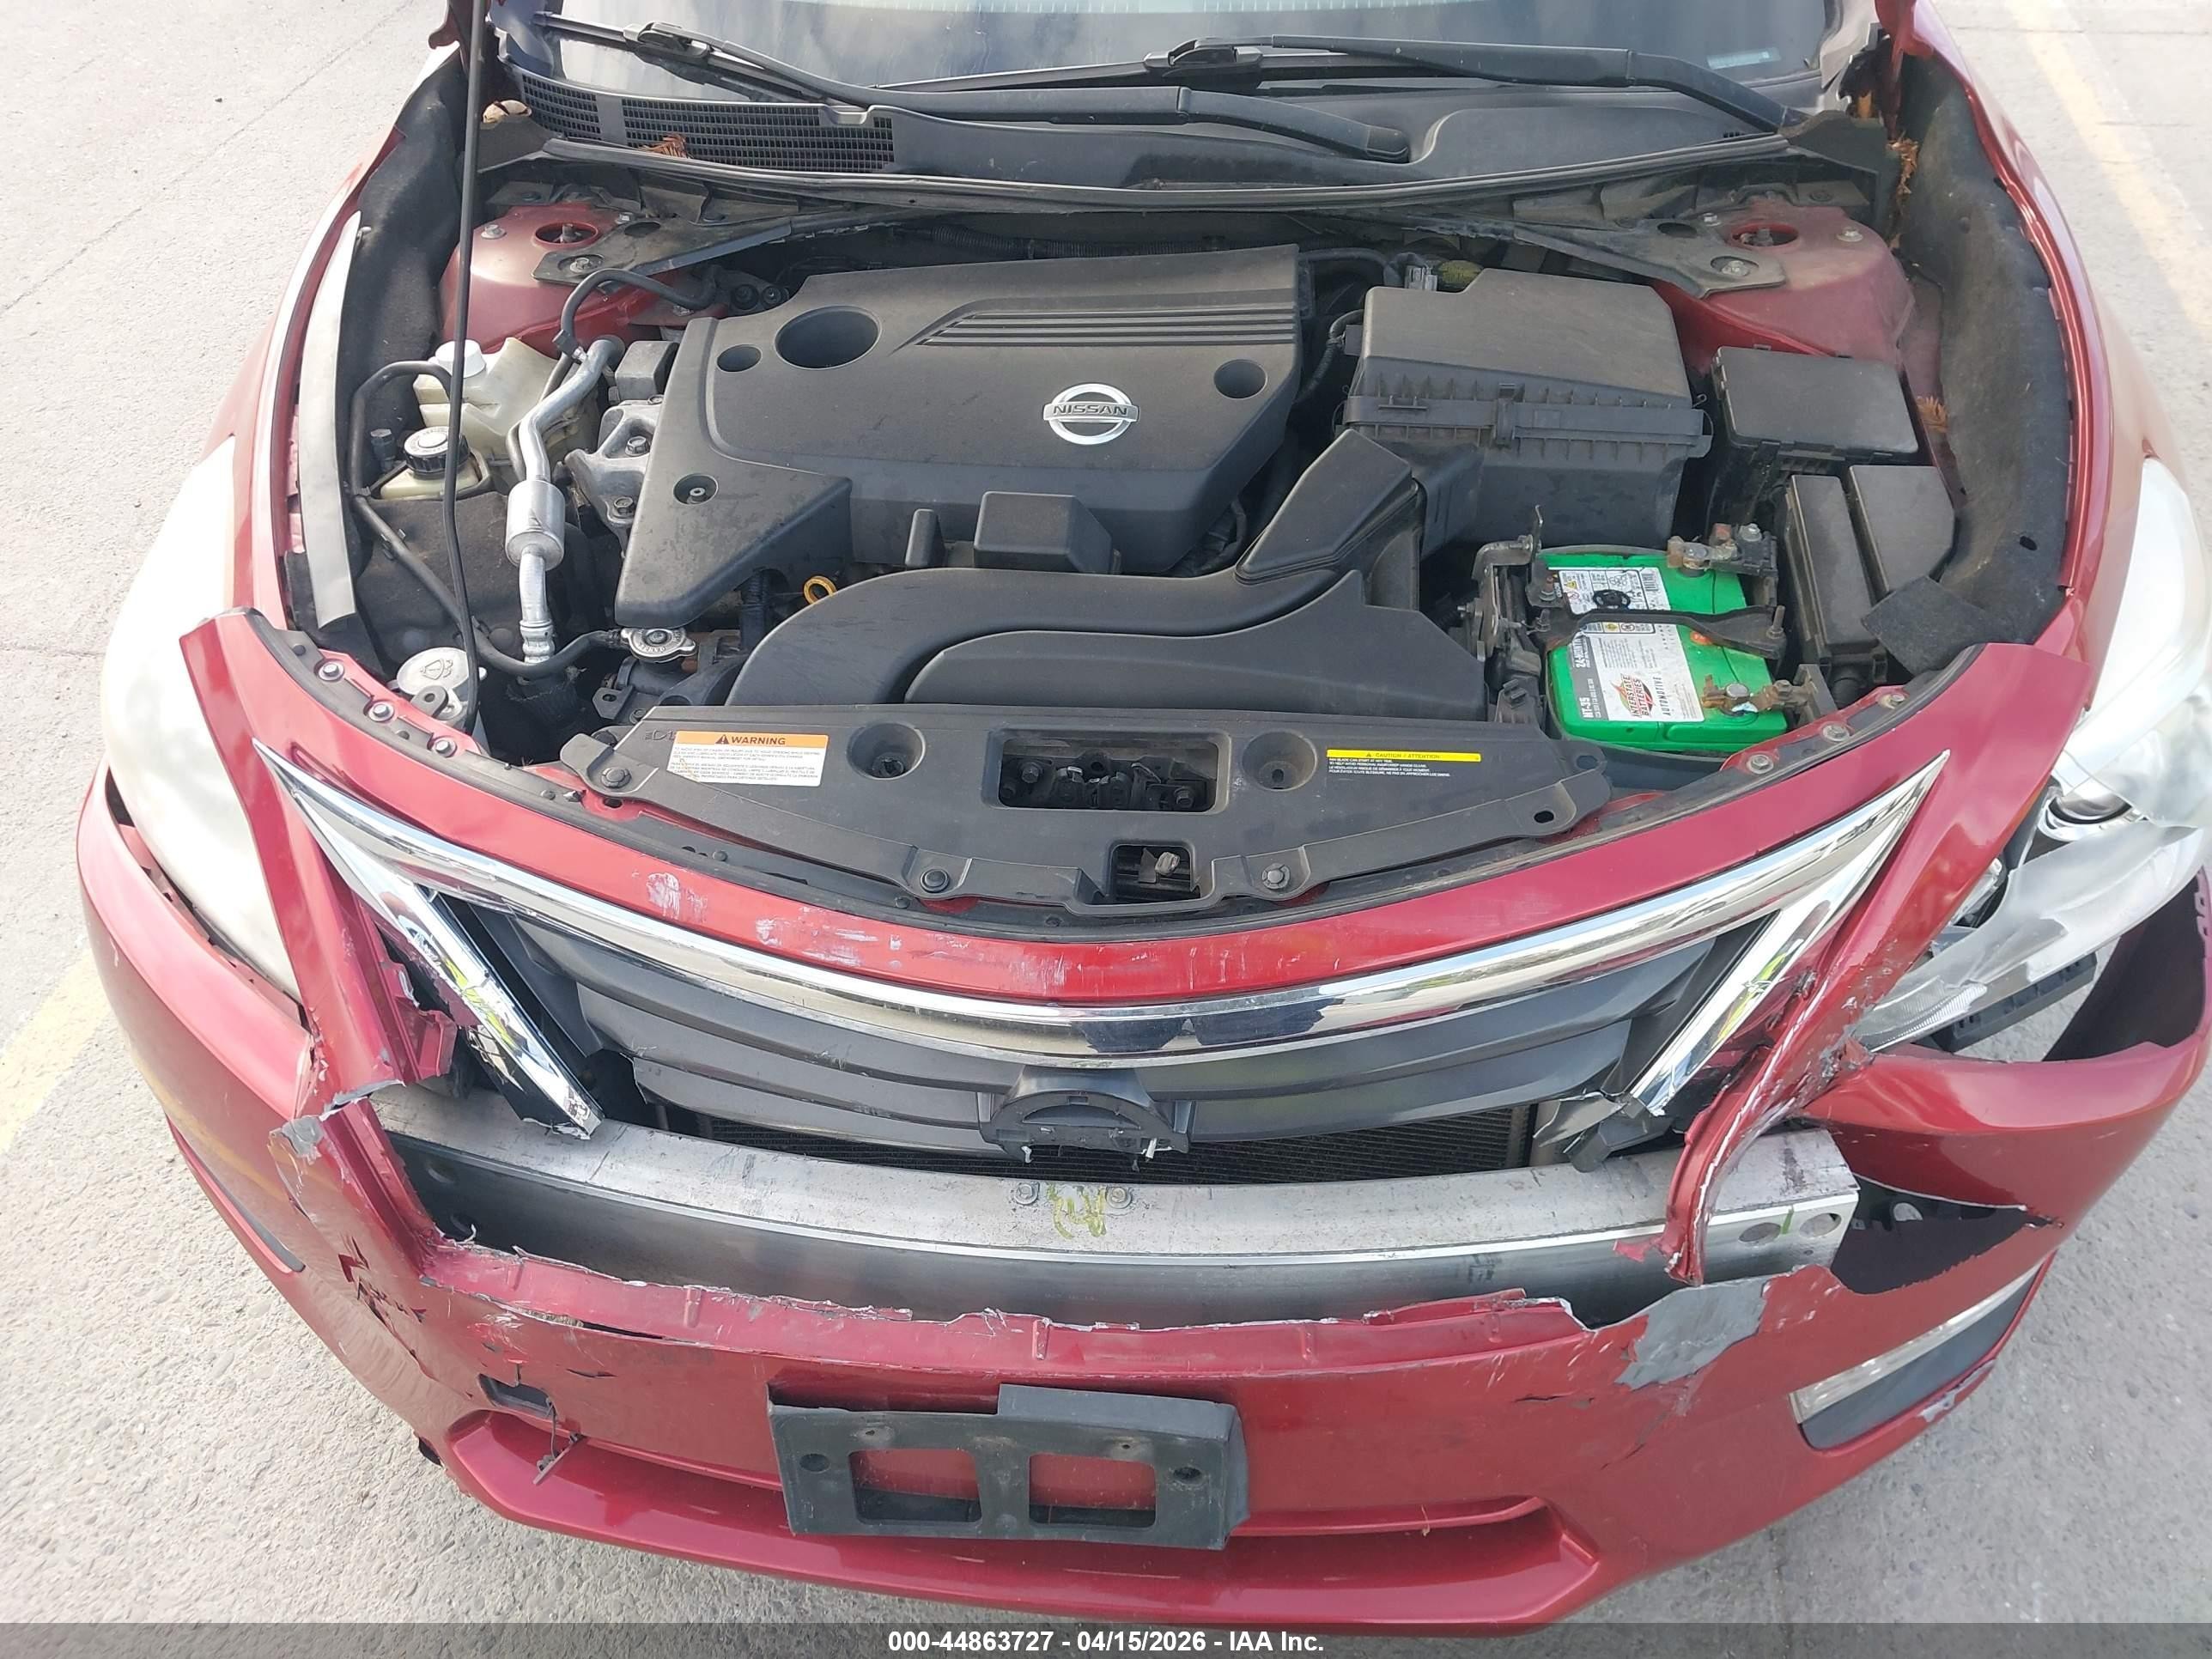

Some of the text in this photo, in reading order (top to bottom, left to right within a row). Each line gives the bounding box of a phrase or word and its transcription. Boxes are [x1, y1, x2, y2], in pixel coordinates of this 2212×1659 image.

[1053, 404, 1127, 416] NISSAN
[1620, 672, 1642, 717] INTERSTATE
[1632, 678, 1650, 716] BATTERIES
[1653, 677, 1672, 716] AUTOMOTIVE
[731, 736, 787, 745] WARNING
